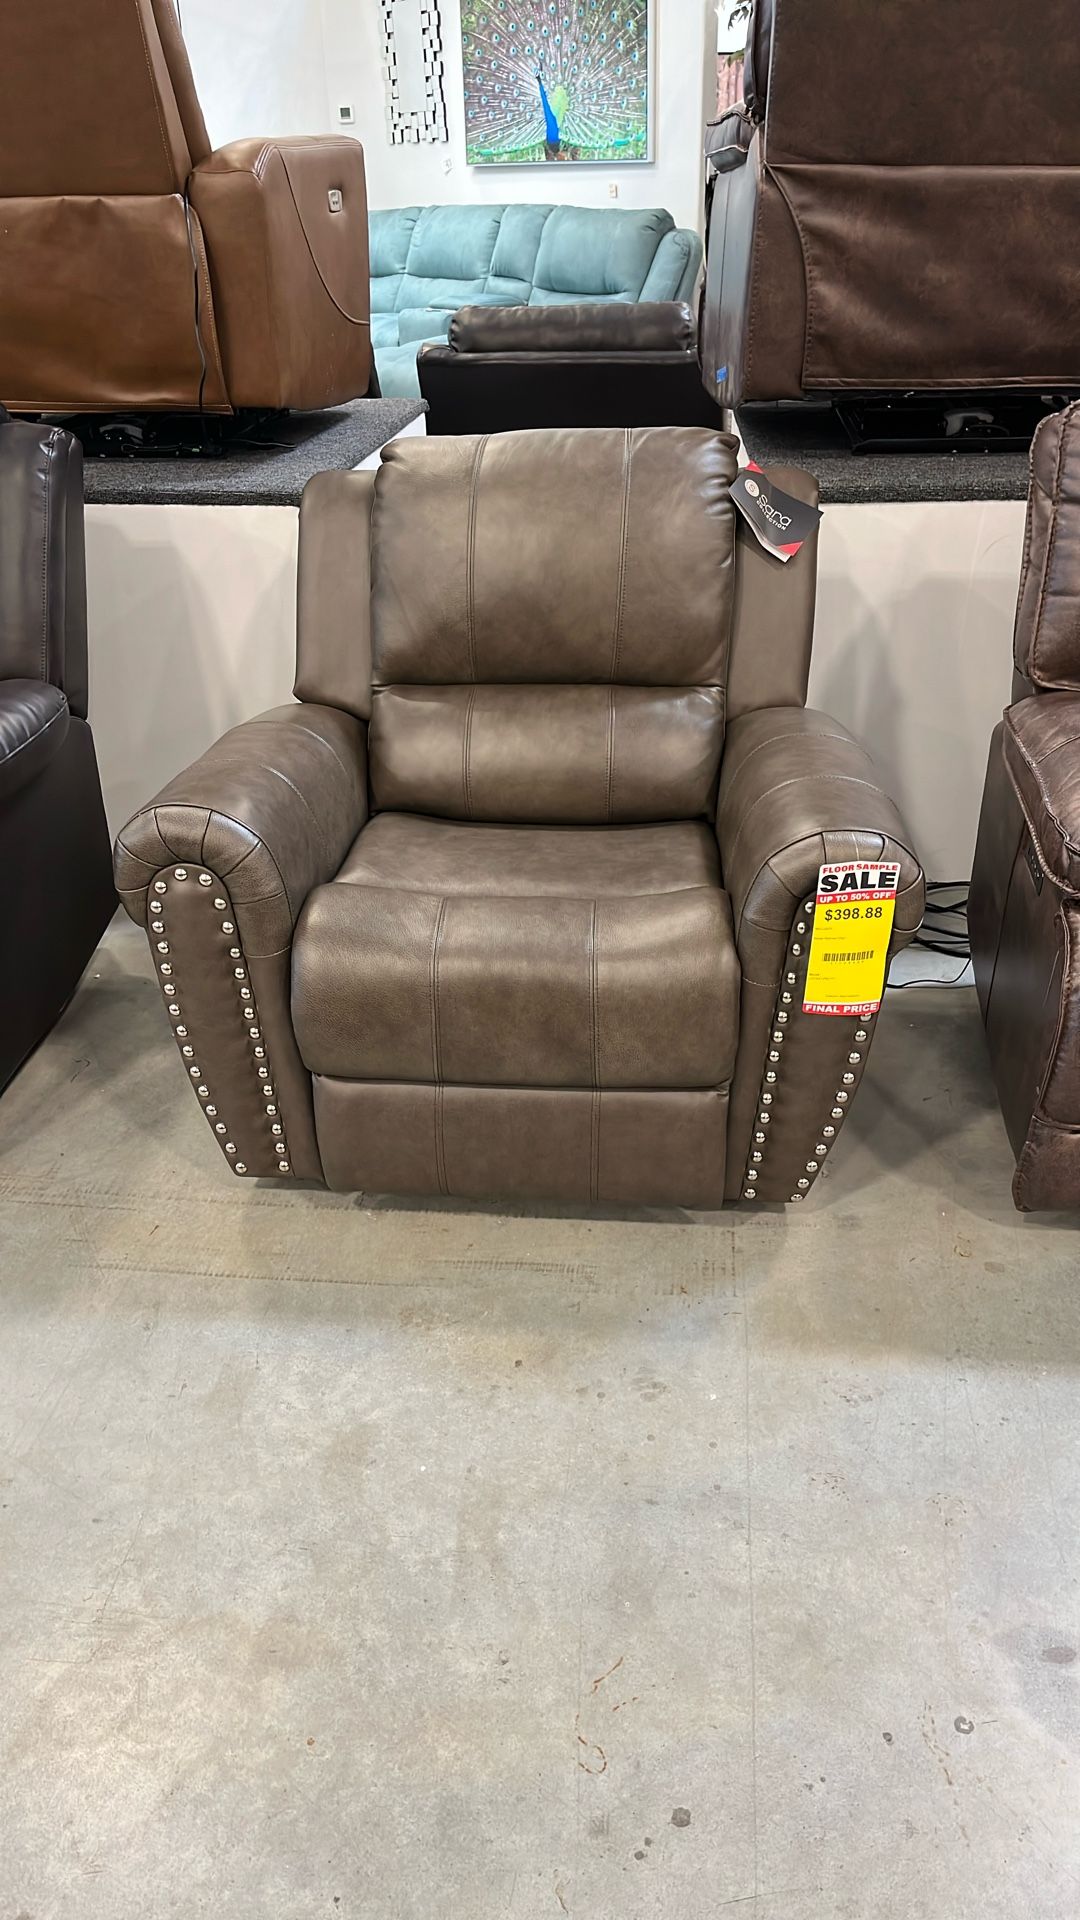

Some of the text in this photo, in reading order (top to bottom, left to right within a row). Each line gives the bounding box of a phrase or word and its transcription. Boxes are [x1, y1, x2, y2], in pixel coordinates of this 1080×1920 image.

[756, 500, 787, 531] COLLECTION
[823, 865, 854, 874] FLOOR
[820, 872, 896, 893] SALE
[825, 907, 883, 922] $398.88
[805, 1003, 877, 1013] FINAL PRICE
